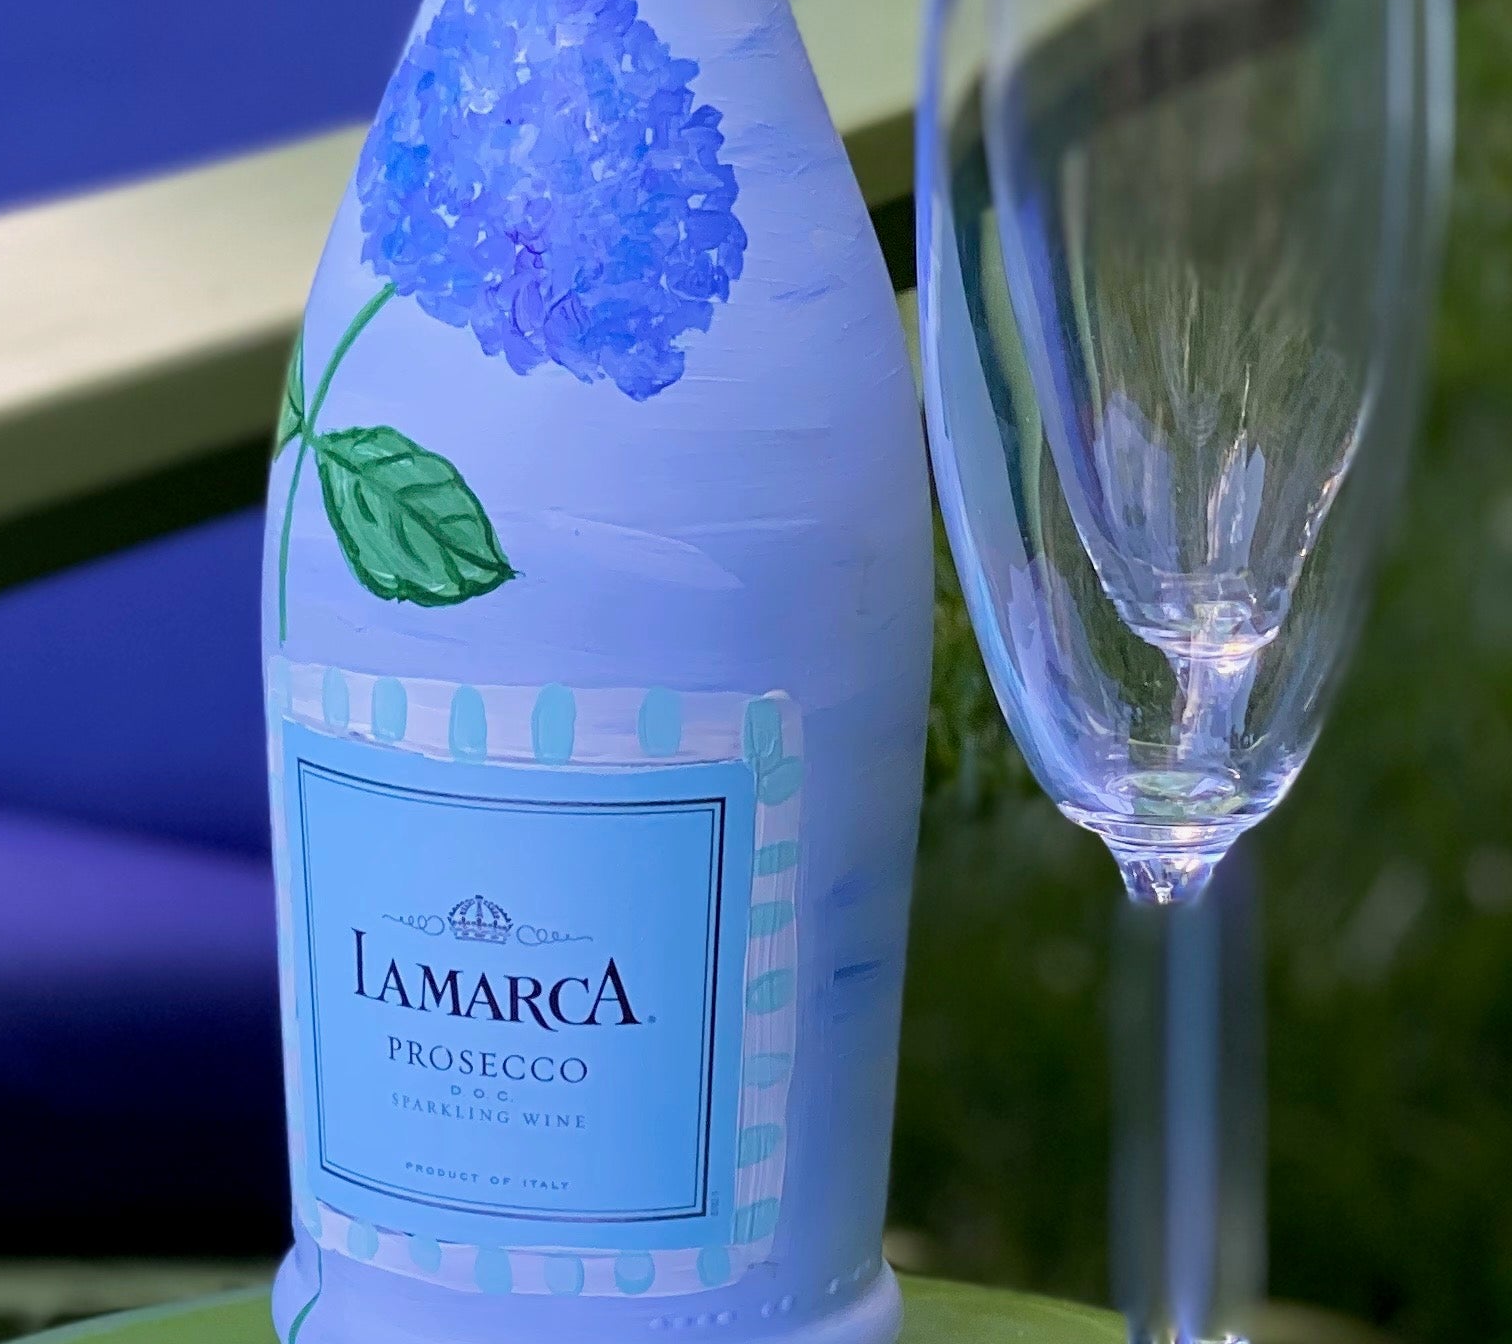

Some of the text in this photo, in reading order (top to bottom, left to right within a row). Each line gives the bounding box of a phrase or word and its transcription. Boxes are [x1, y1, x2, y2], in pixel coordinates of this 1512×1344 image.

[388, 1035, 589, 1084] PROSECCO
[391, 1092, 587, 1130] SPARKLING WINE
[405, 1161, 570, 1191] PRODUCT OF ITALY
